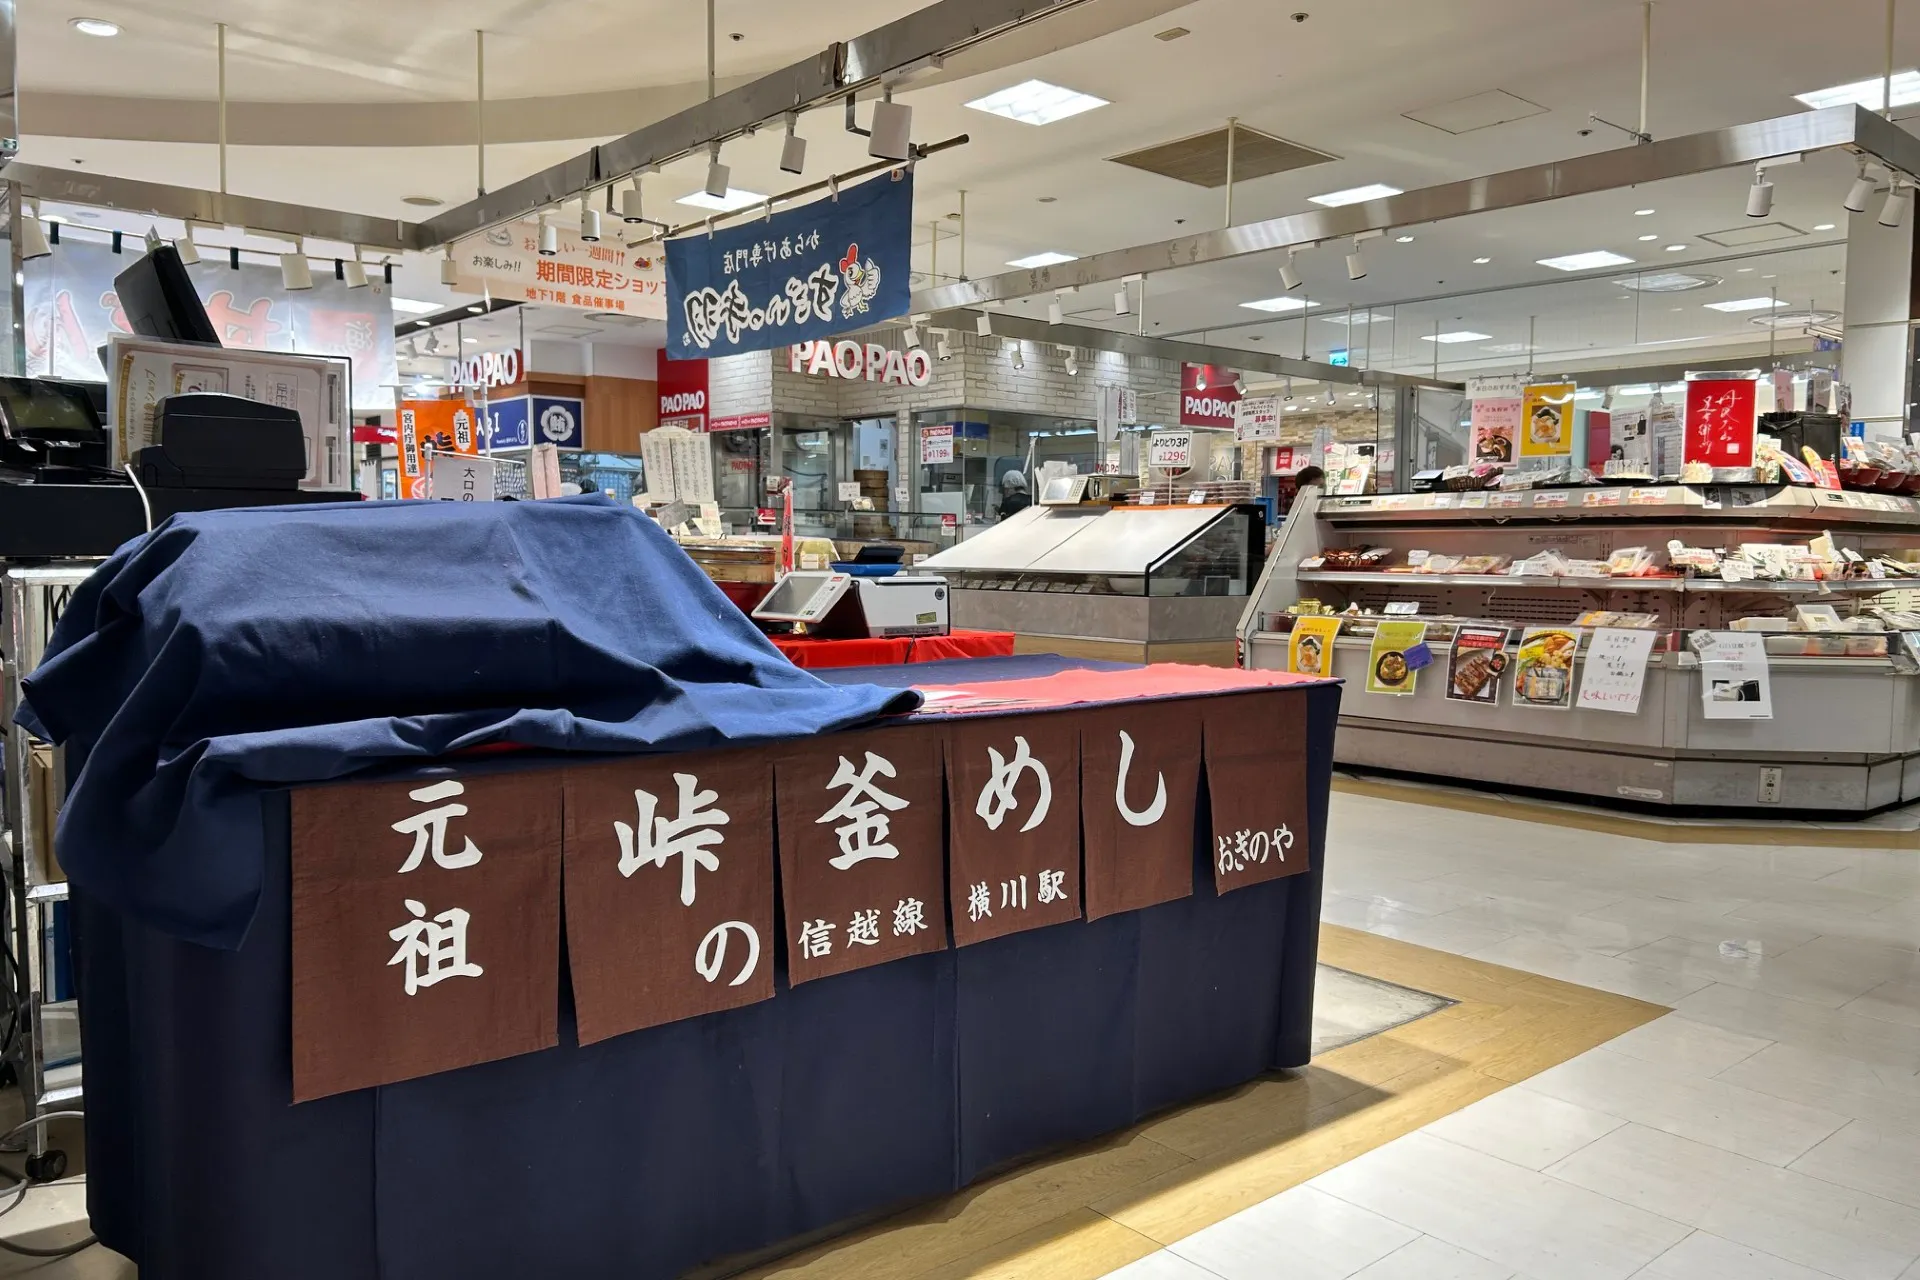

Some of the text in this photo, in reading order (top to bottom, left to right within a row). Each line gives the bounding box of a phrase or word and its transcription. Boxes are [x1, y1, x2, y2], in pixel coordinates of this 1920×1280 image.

[472, 255, 521, 273] お楽しみ!!
[526, 288, 626, 311] 地下1階 食品催事場
[450, 348, 518, 393] PAOPAO
[790, 340, 932, 387] PAOPAO
[661, 390, 705, 414] PAOPAO
[403, 413, 417, 473] 宮内庁御用達
[456, 418, 470, 444] 元祖
[1153, 437, 1188, 448] よりどり3P
[1217, 822, 1295, 876] おぎのや
[387, 779, 484, 996] 元祖
[614, 771, 762, 986] 峠の
[967, 869, 1068, 922] 横川駅
[798, 897, 929, 961] 信越線
